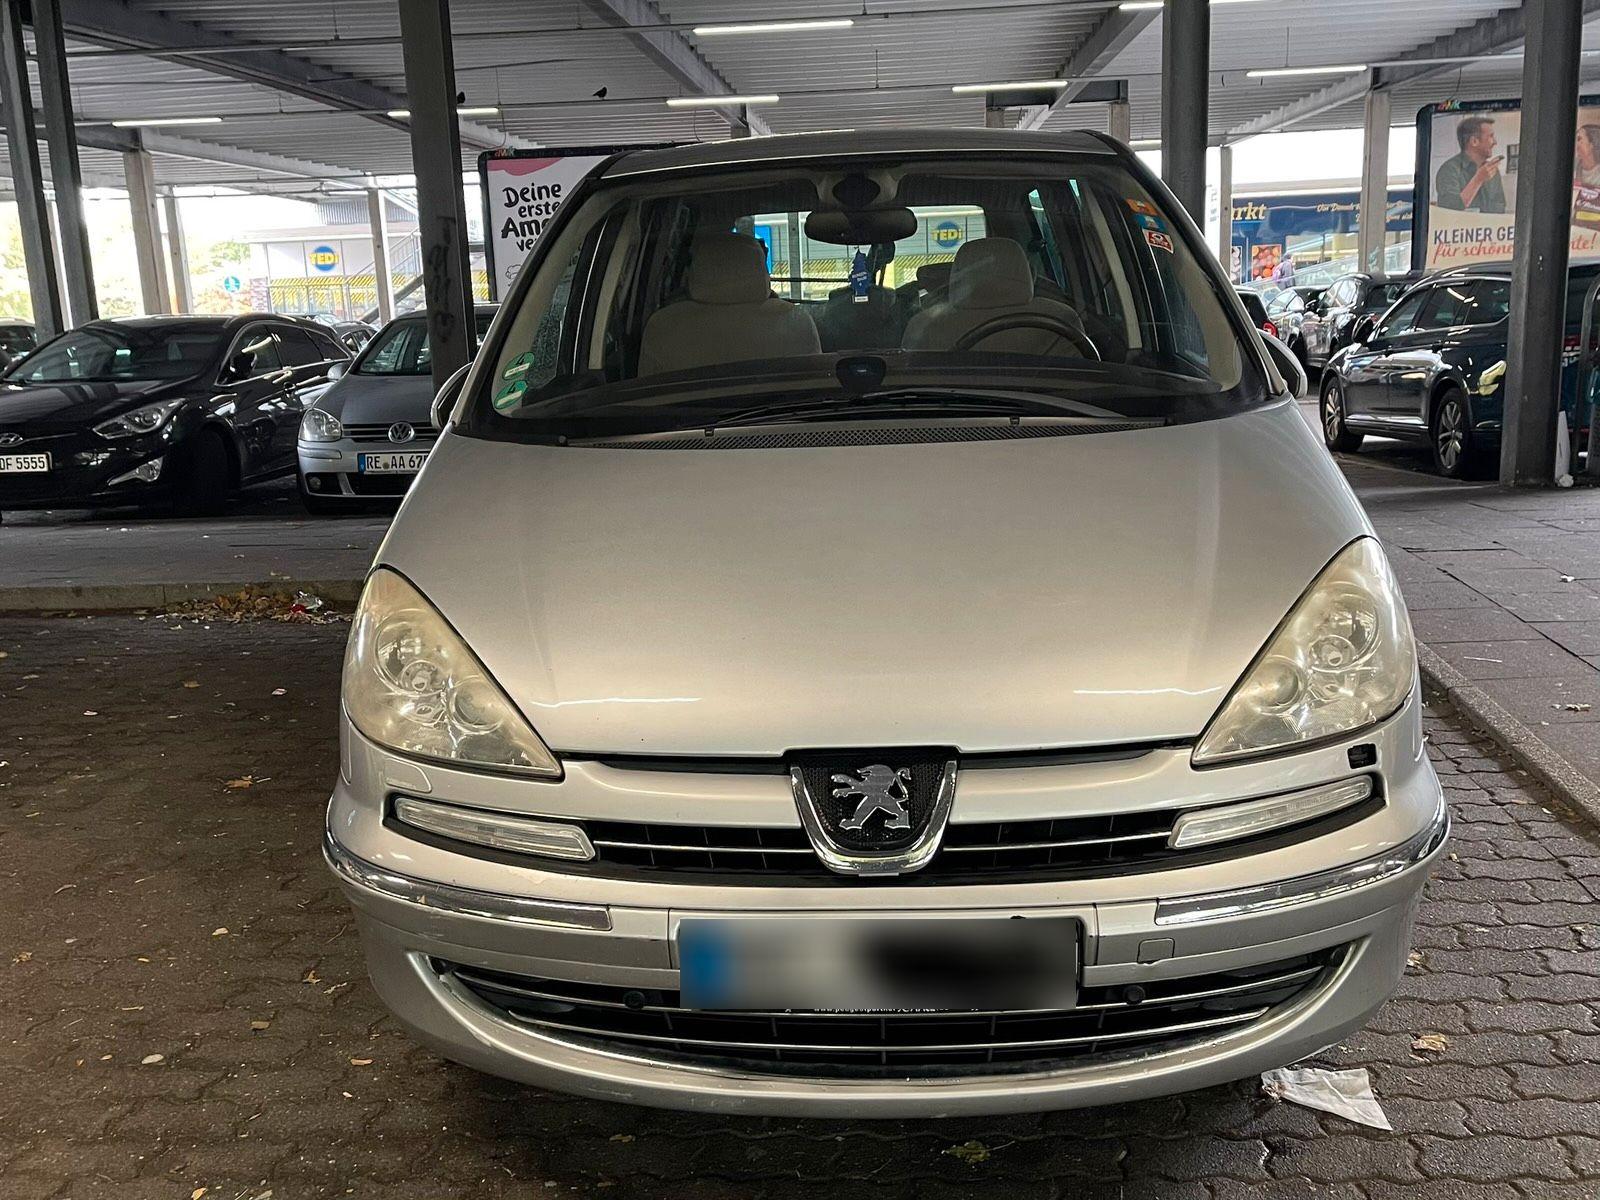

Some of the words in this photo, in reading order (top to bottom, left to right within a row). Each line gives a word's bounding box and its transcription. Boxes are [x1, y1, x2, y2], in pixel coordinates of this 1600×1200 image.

[502, 182, 562, 208] Deine
[1497, 226, 1515, 241] GE
[516, 238, 538, 252] ve
[1433, 241, 1457, 264] für
[16, 456, 45, 470] 5555
[366, 455, 381, 470] RE
[390, 455, 405, 470] AA
